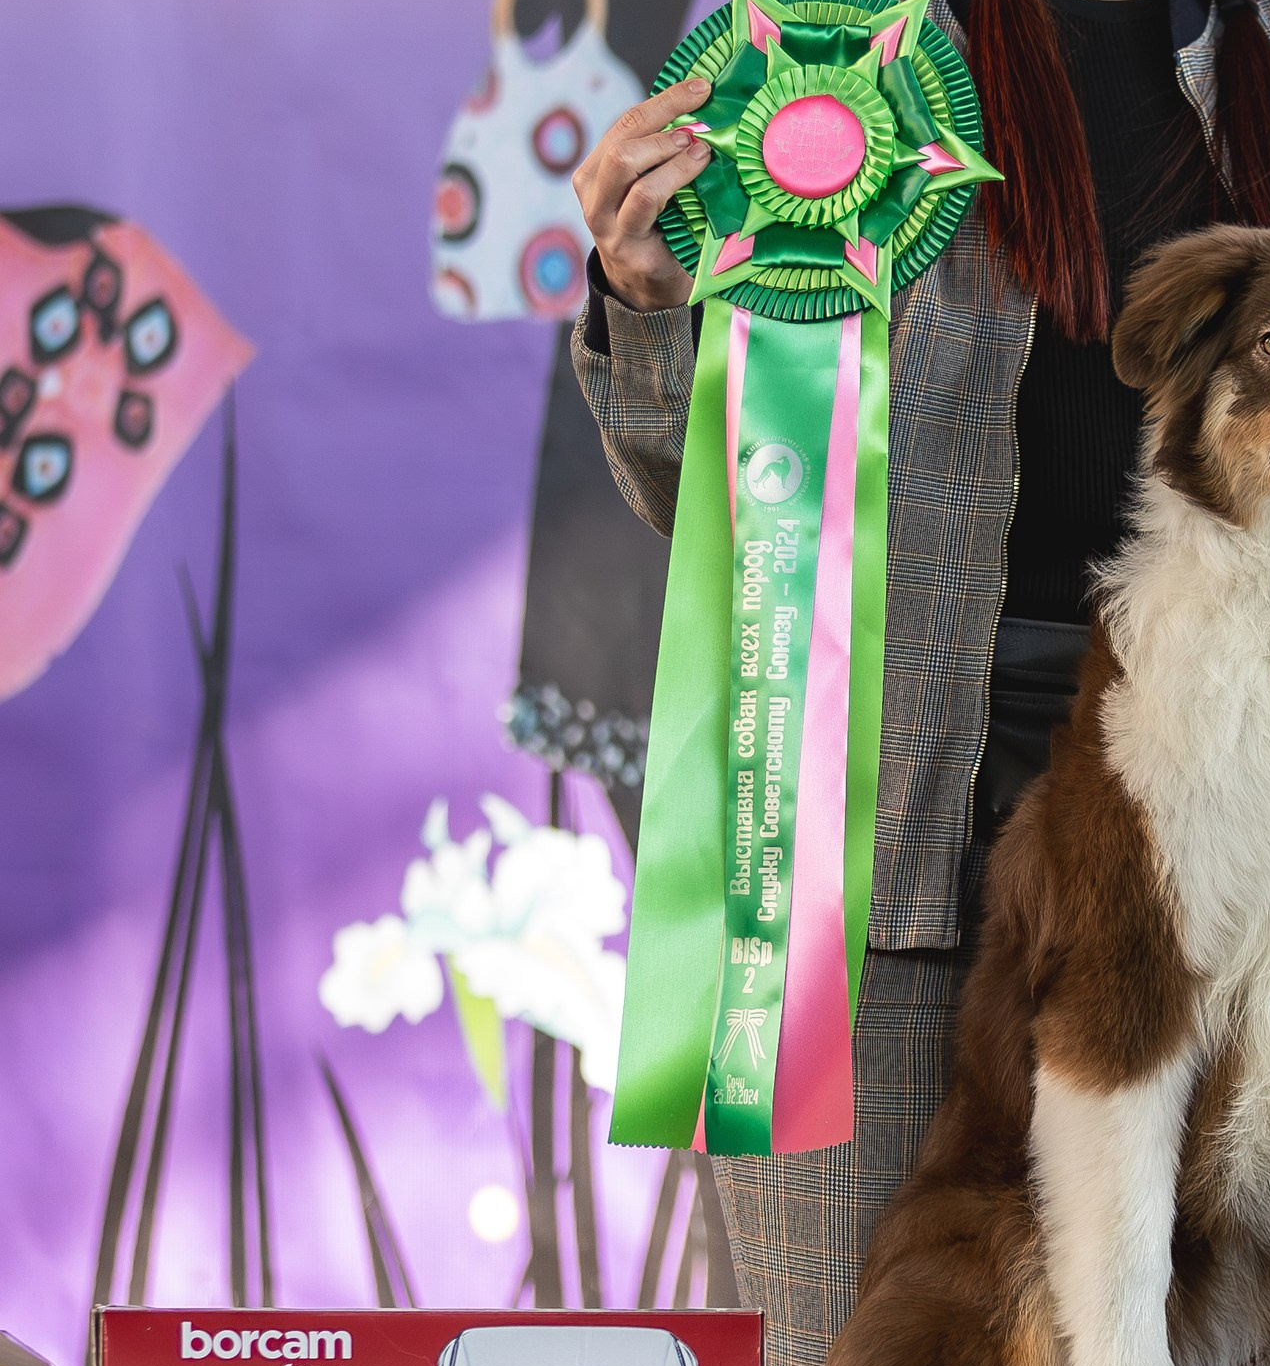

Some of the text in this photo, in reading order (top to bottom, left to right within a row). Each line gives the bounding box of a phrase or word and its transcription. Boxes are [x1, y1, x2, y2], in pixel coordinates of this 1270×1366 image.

[773, 518, 801, 574] 2024
[765, 606, 798, 680] Союзу
[729, 539, 773, 896] Выставка собак всех пород
[759, 696, 792, 838] Советскому
[756, 846, 783, 922] Служу
[730, 937, 774, 967] BISp
[742, 966, 756, 994] 2
[713, 1088, 759, 1105] 25.02.2024
[726, 1073, 746, 1089] Сочи
[181, 1321, 352, 1360] borcam
